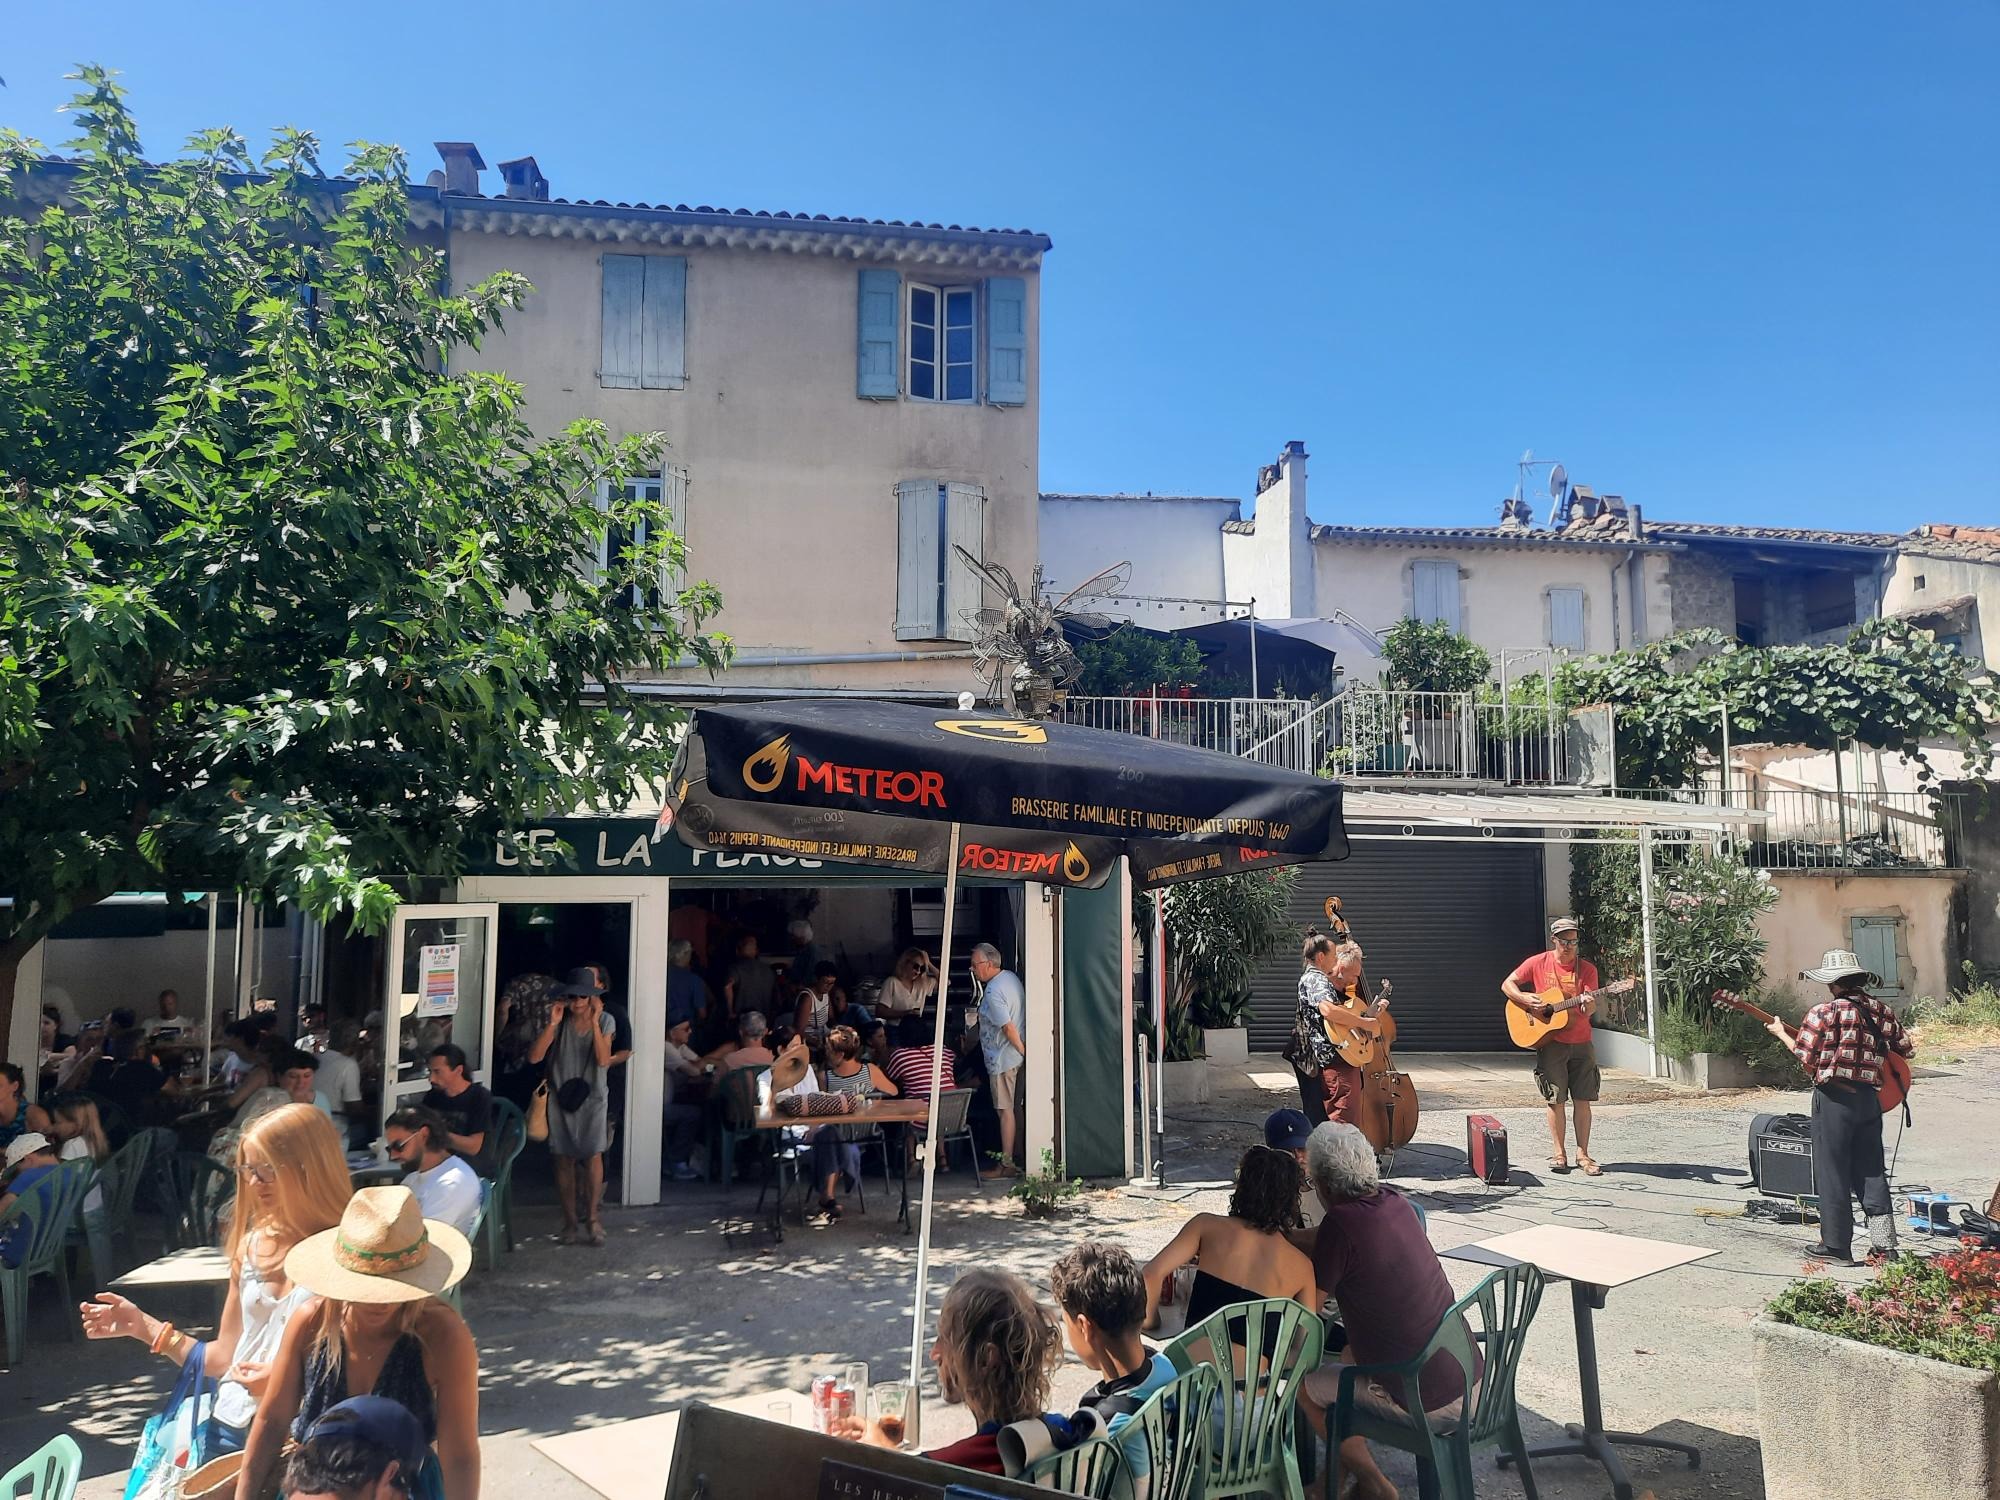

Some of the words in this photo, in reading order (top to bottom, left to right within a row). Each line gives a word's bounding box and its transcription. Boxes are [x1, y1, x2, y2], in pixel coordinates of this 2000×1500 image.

[796, 756, 947, 808] METEOR
[1011, 797, 1069, 820] BRASSERIE
[1074, 804, 1127, 827] FAMILIALE
[1130, 810, 1143, 828] ET
[1146, 812, 1224, 834] INDEPENDANTE
[1228, 818, 1265, 838] DEPUIS
[1268, 822, 1290, 841] 1640
[596, 831, 651, 867] LA
[834, 1479, 861, 1496] LES
